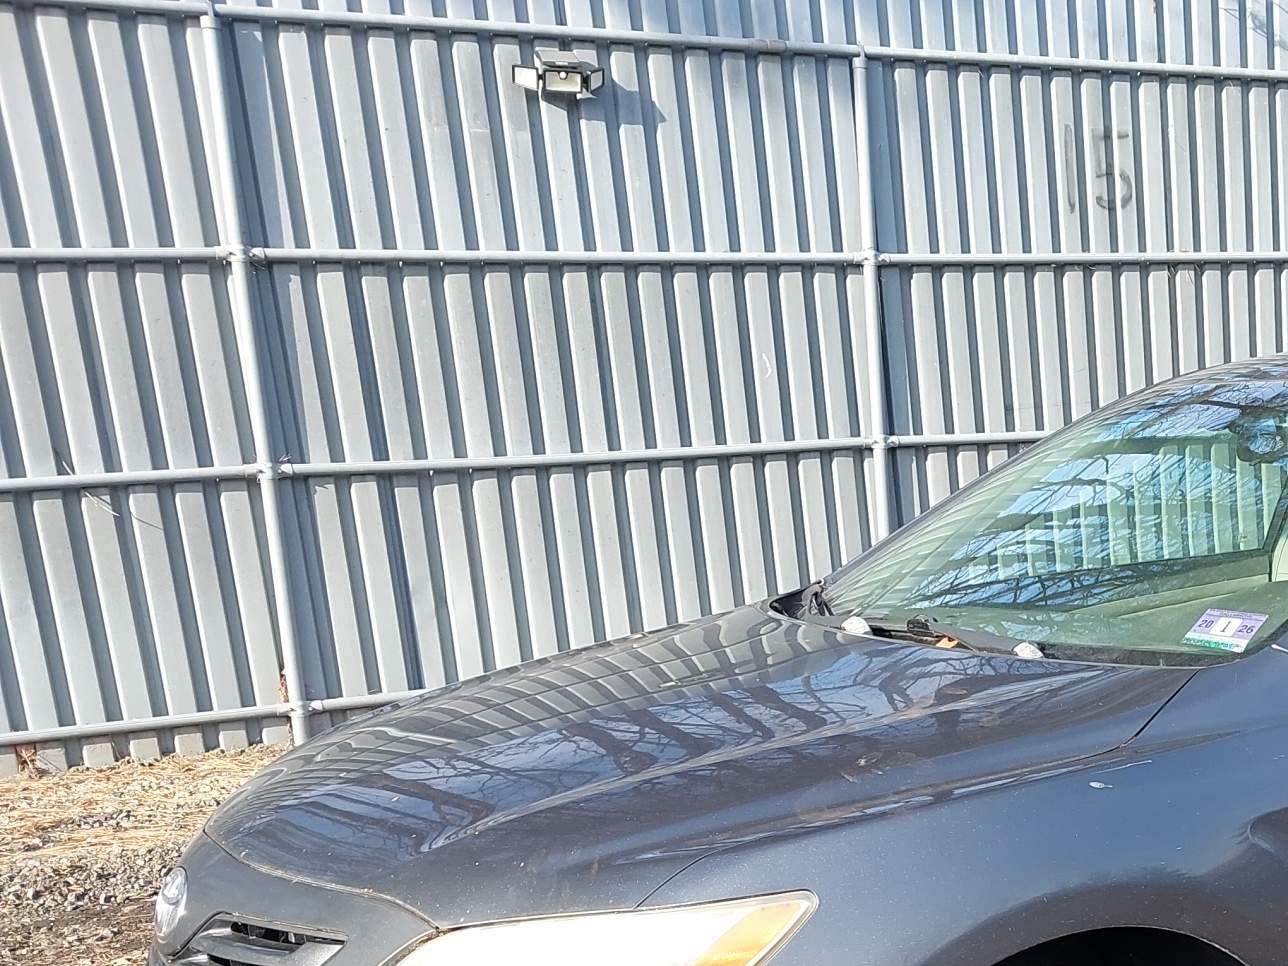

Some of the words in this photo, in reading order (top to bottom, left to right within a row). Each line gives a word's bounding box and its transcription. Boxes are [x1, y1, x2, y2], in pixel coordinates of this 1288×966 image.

[1063, 122, 1133, 214] 15
[1198, 619, 1215, 629] 20
[1237, 624, 1256, 634] 26
